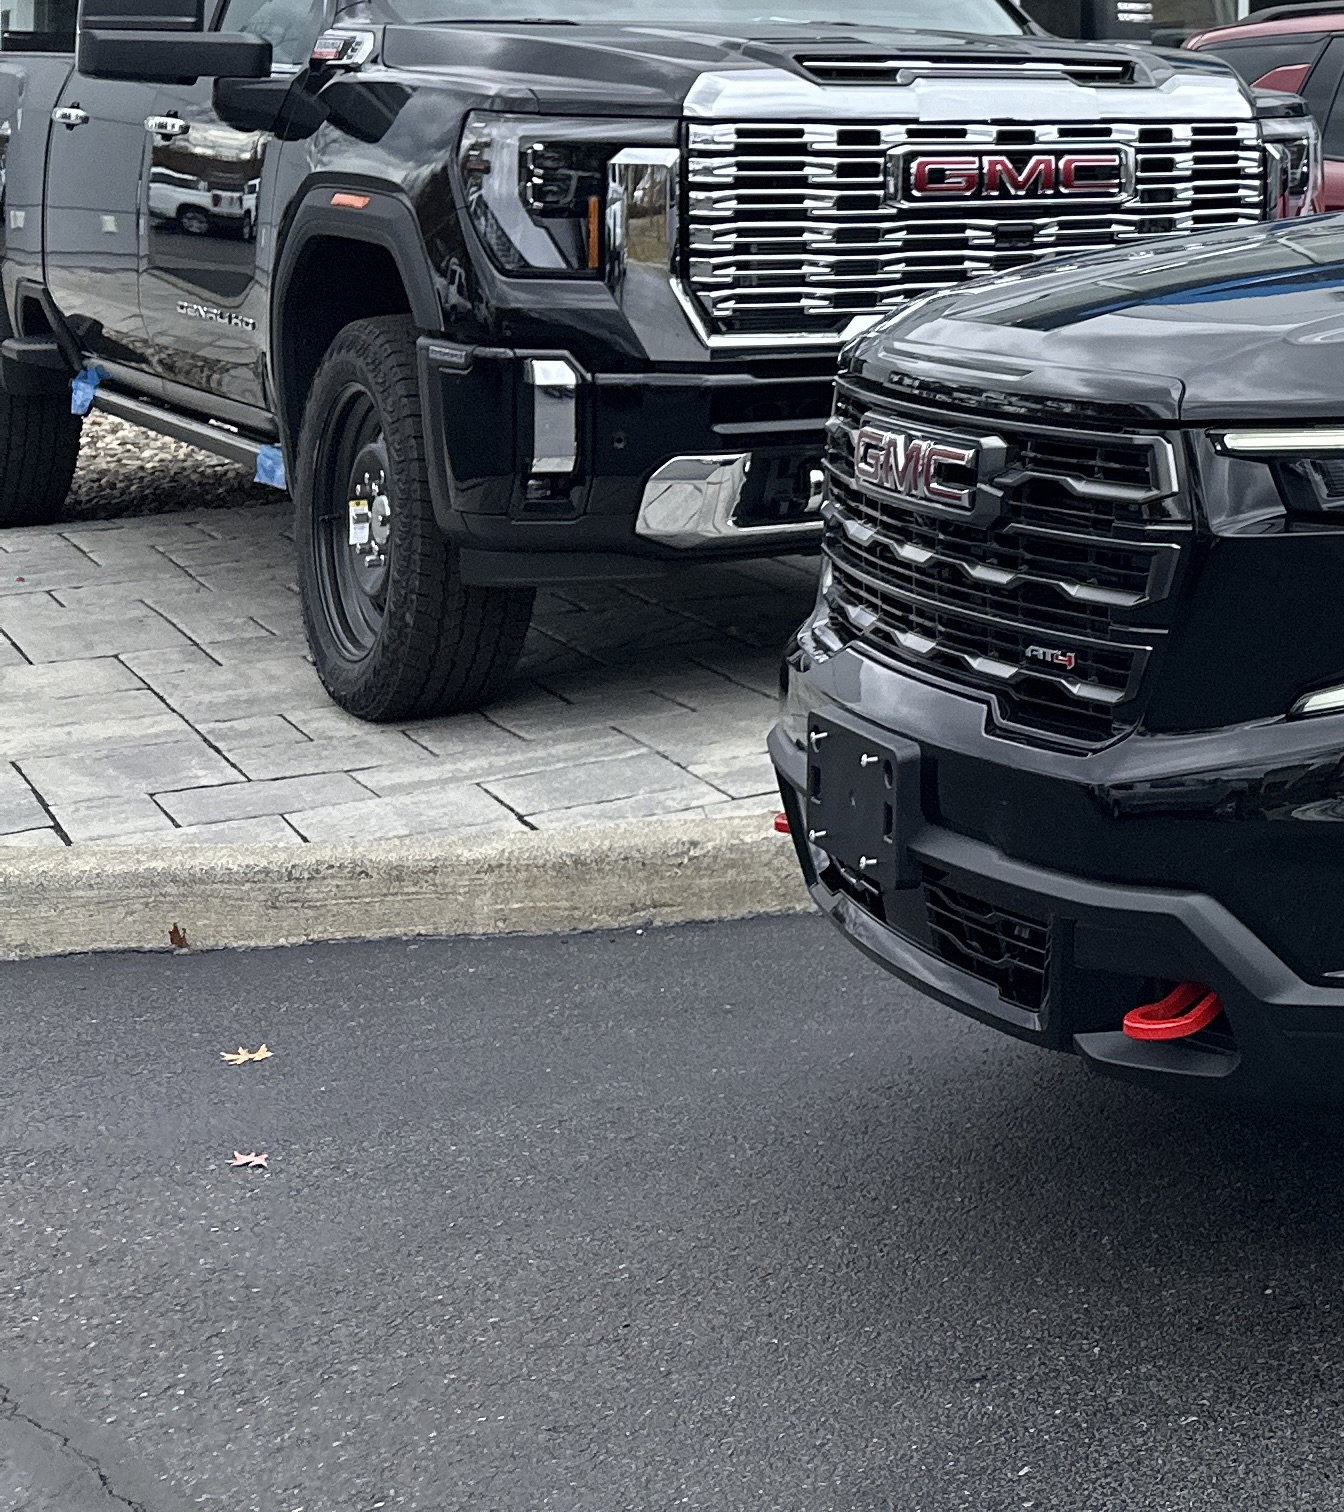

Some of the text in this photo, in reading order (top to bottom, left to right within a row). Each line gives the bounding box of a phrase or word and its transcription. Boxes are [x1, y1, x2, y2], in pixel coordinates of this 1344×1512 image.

[910, 155, 1120, 196] GMC
[855, 426, 976, 507] GMC
[1025, 645, 1075, 669] AT4
